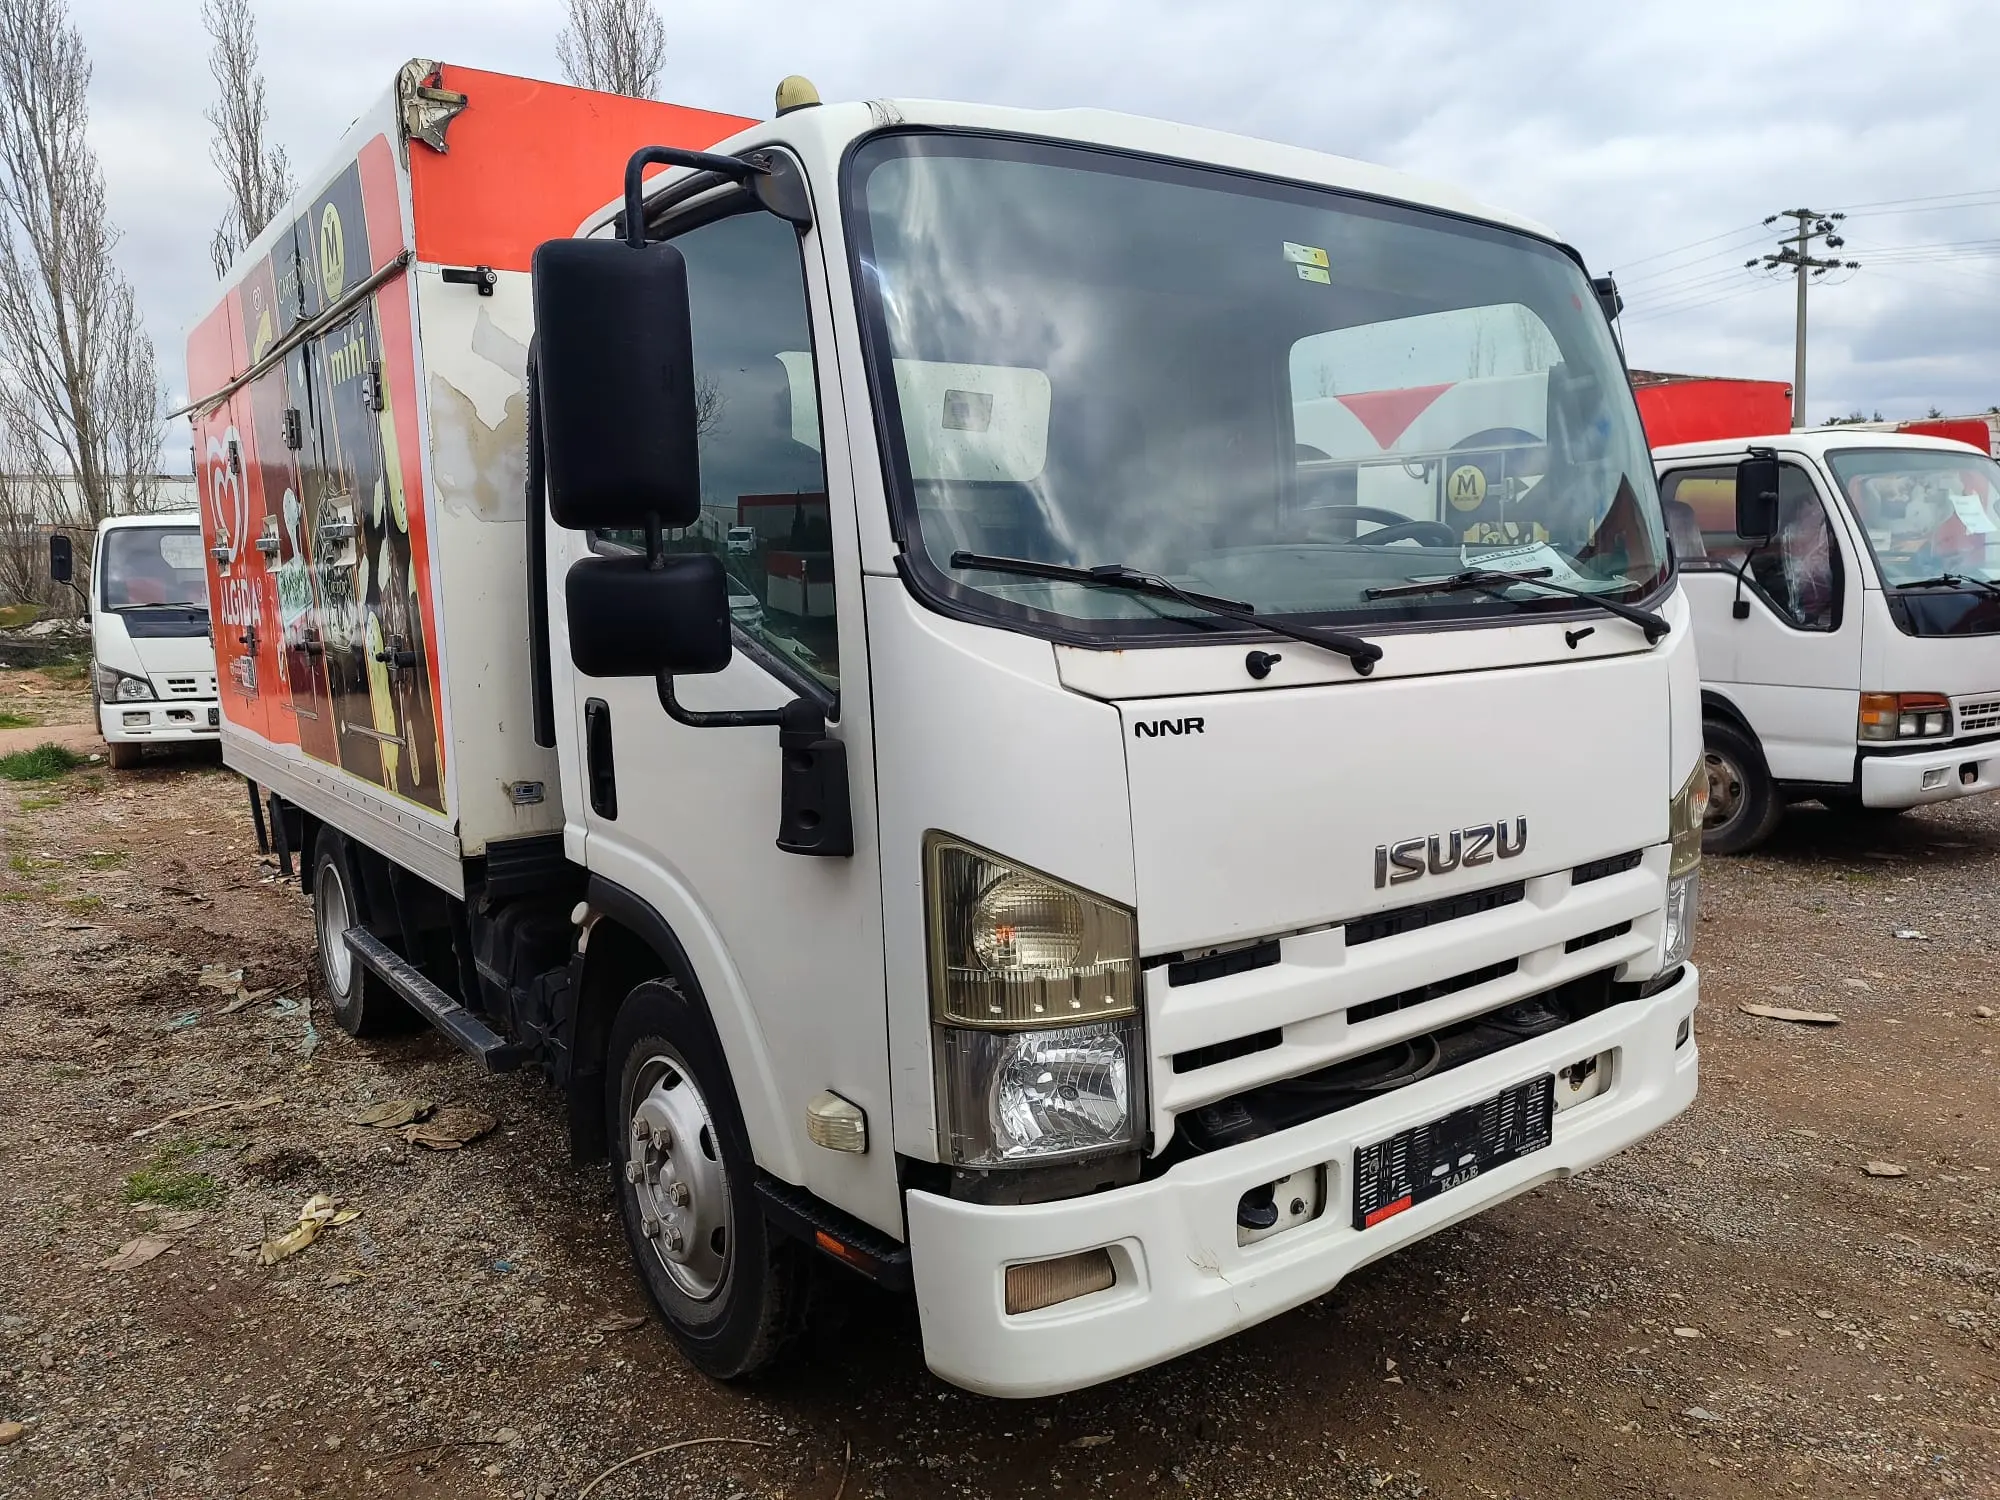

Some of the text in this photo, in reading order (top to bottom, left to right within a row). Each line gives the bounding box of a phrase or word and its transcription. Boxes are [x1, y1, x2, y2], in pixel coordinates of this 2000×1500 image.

[329, 321, 368, 387] mini
[1134, 716, 1206, 739] NNR
[1373, 815, 1528, 888] ISUZU
[1440, 1164, 1479, 1193] KALE
